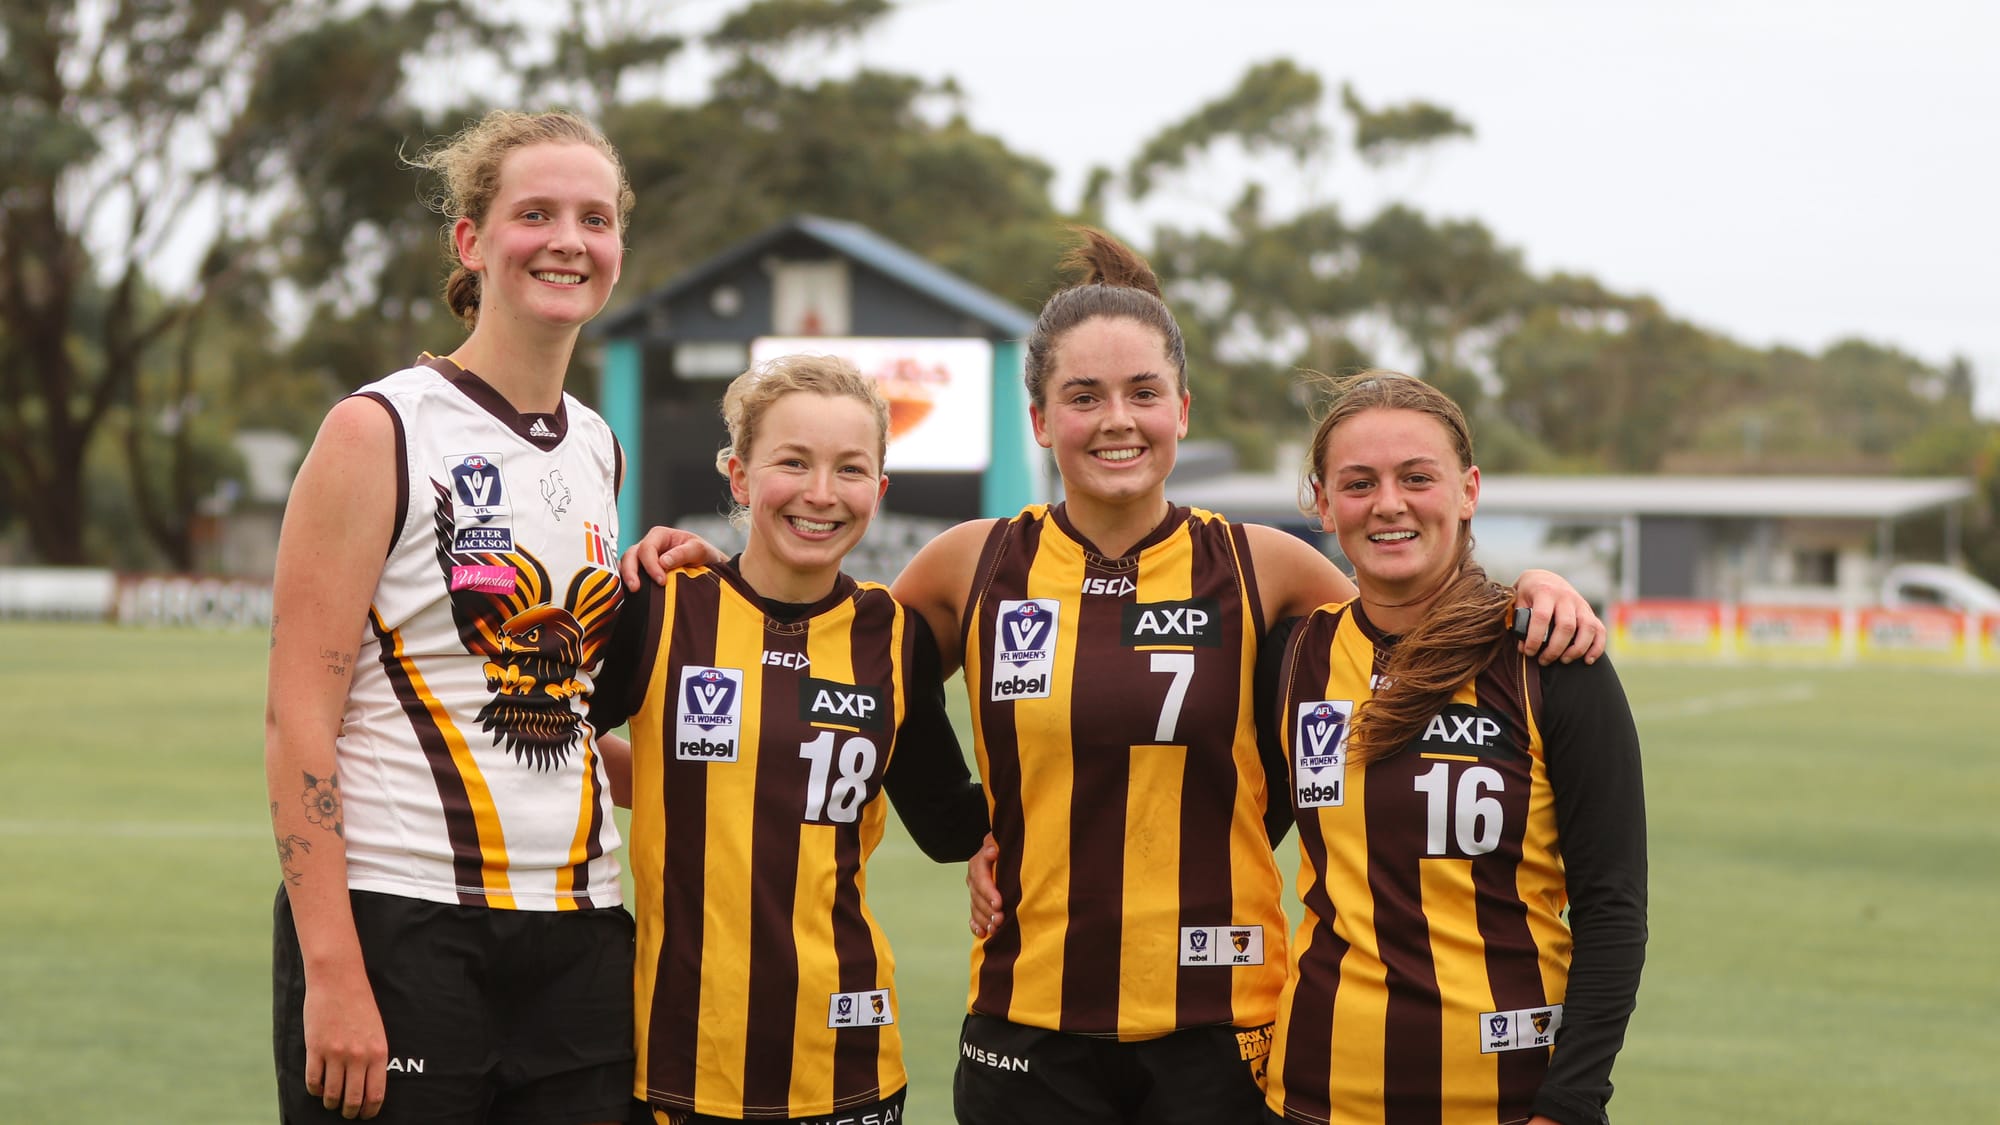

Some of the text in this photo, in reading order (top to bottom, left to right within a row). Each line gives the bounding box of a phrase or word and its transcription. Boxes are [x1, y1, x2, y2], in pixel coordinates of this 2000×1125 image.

[466, 457, 486, 466] AFL
[465, 529, 502, 539] PETER
[457, 539, 510, 549] JACKSON
[1082, 577, 1119, 594] ISC
[1019, 605, 1039, 613] AFL
[1134, 608, 1209, 636] AXP
[761, 650, 796, 666] ISC
[1000, 651, 1046, 661] VFL WOMEN'S
[702, 671, 722, 679] AFL
[994, 674, 1046, 696] rebel
[811, 689, 876, 718] AXP
[1150, 653, 1195, 742] 7
[1314, 706, 1332, 715] AFL
[684, 715, 733, 724] VFL WOMEN'S
[1422, 714, 1501, 745] AXP
[679, 738, 734, 757] rebel
[1300, 756, 1338, 767] VFL WOMEN'S
[799, 731, 877, 823] 18
[1299, 781, 1339, 803] rebel
[1414, 763, 1505, 856] 16
[1235, 1029, 1265, 1045] BOX
[1535, 1035, 1549, 1045] ISC
[962, 1041, 1029, 1073] NISSAN
